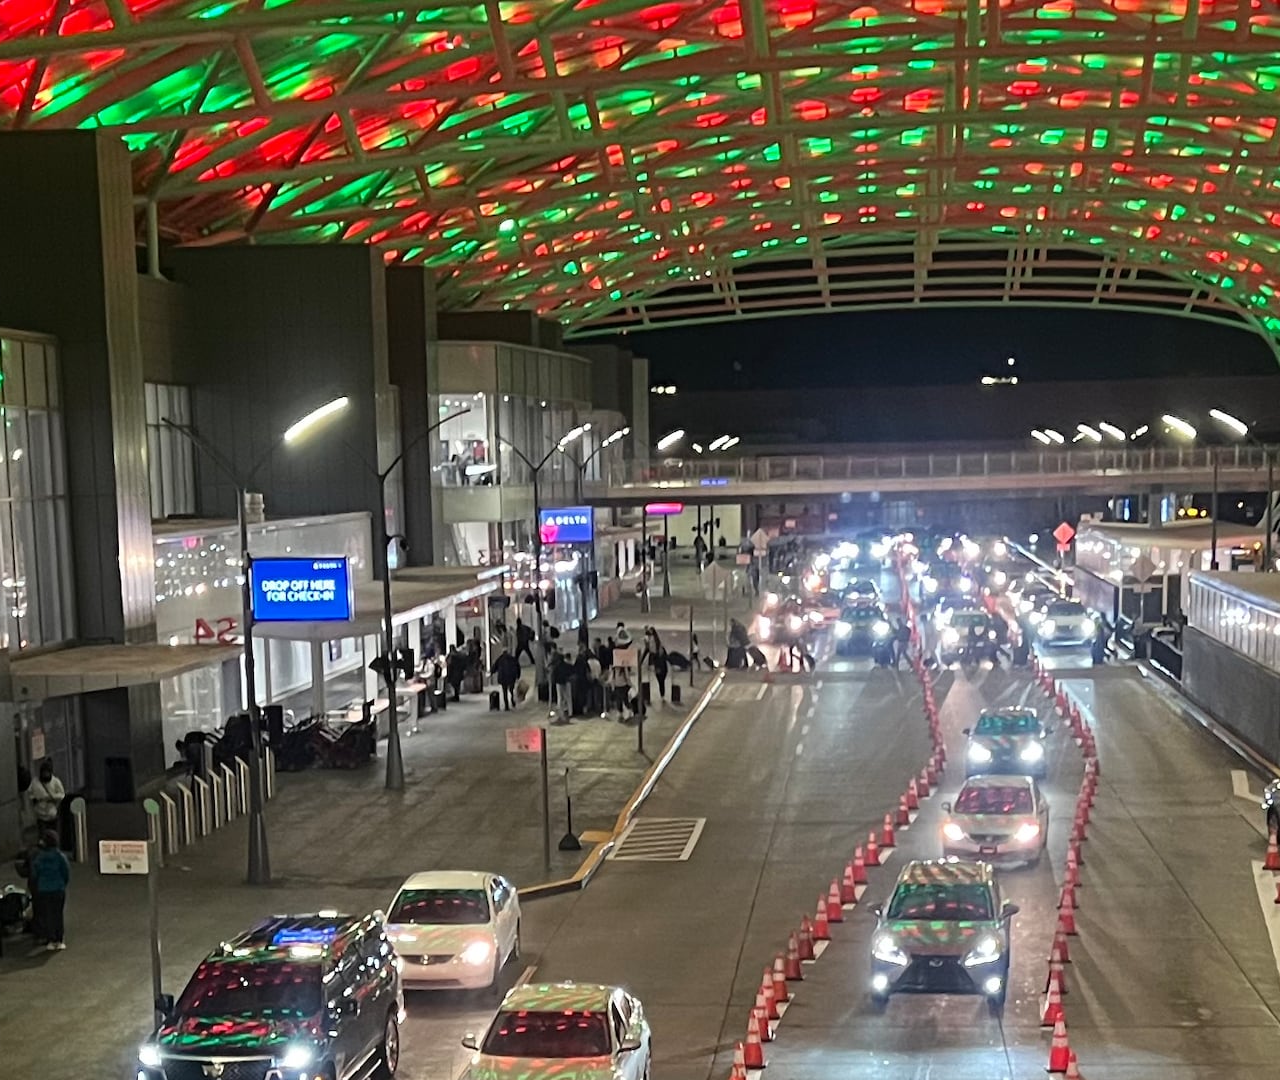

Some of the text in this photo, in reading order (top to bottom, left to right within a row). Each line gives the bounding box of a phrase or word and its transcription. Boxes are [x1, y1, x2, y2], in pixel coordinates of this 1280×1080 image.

[261, 580, 335, 592] DROP OFF HERE
[266, 591, 335, 602] FOR CHECK-IN
